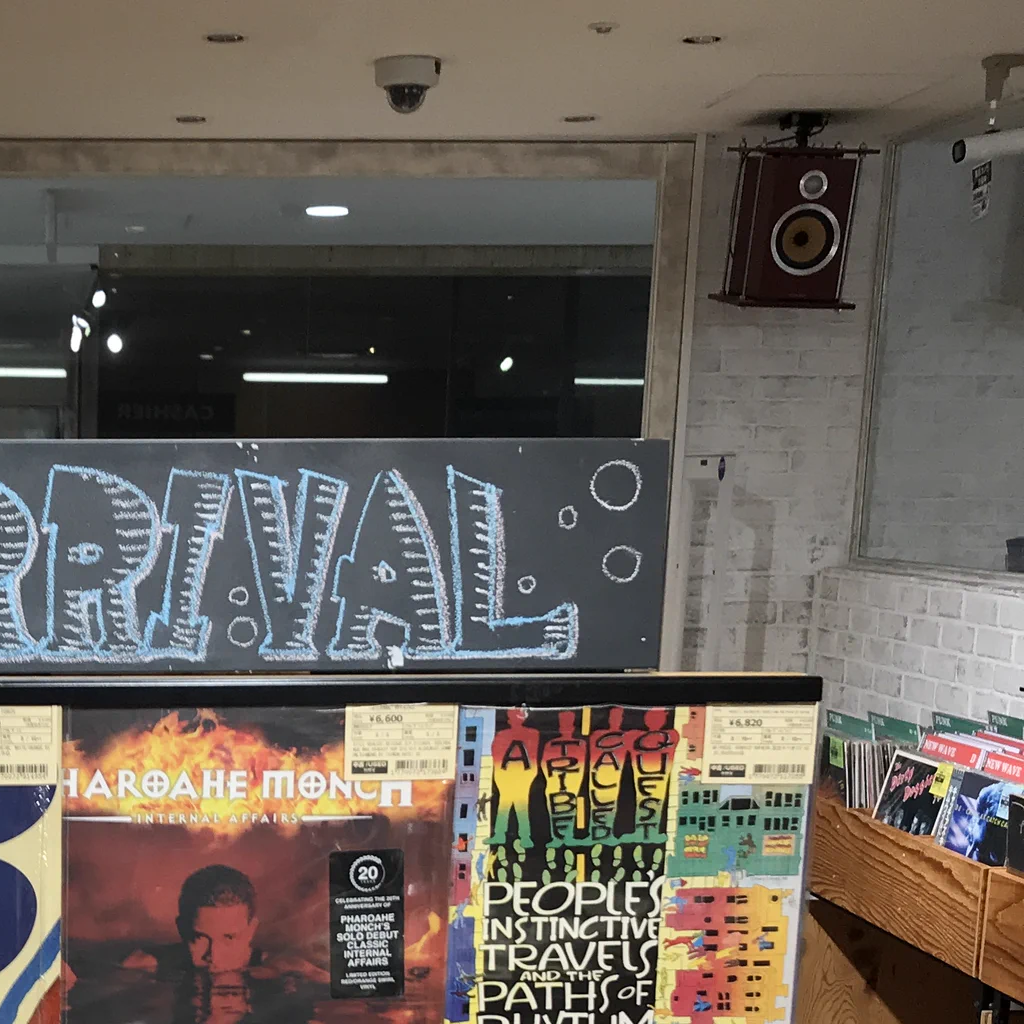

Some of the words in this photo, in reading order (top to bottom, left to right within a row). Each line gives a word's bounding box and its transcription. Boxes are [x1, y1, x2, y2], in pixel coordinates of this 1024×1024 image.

[369, 714, 403, 723] ¥6,600
[501, 740, 531, 771] A
[546, 740, 581, 840] TRIBE
[591, 731, 625, 840] CALLED
[633, 730, 674, 840] QUEST
[136, 814, 222, 825] INTERNAL
[228, 812, 299, 824] AFFAIRS
[358, 866, 379, 880] 20
[483, 871, 666, 918] PEOPLE'S
[340, 913, 395, 924] PHAROAHE
[345, 922, 390, 933] MONCH'S
[481, 915, 662, 944] INSTINCTIVE
[336, 932, 364, 942] SOLO
[365, 930, 399, 941] DEBUT
[346, 940, 389, 950] CLASSIC
[343, 948, 392, 959] INTERNAL
[479, 940, 658, 979] TRAVELS
[347, 957, 389, 968] AFFAIRS
[519, 970, 561, 982] AND
[566, 969, 604, 981] THE
[477, 974, 619, 1014] PATHS
[617, 980, 653, 1006] OF
